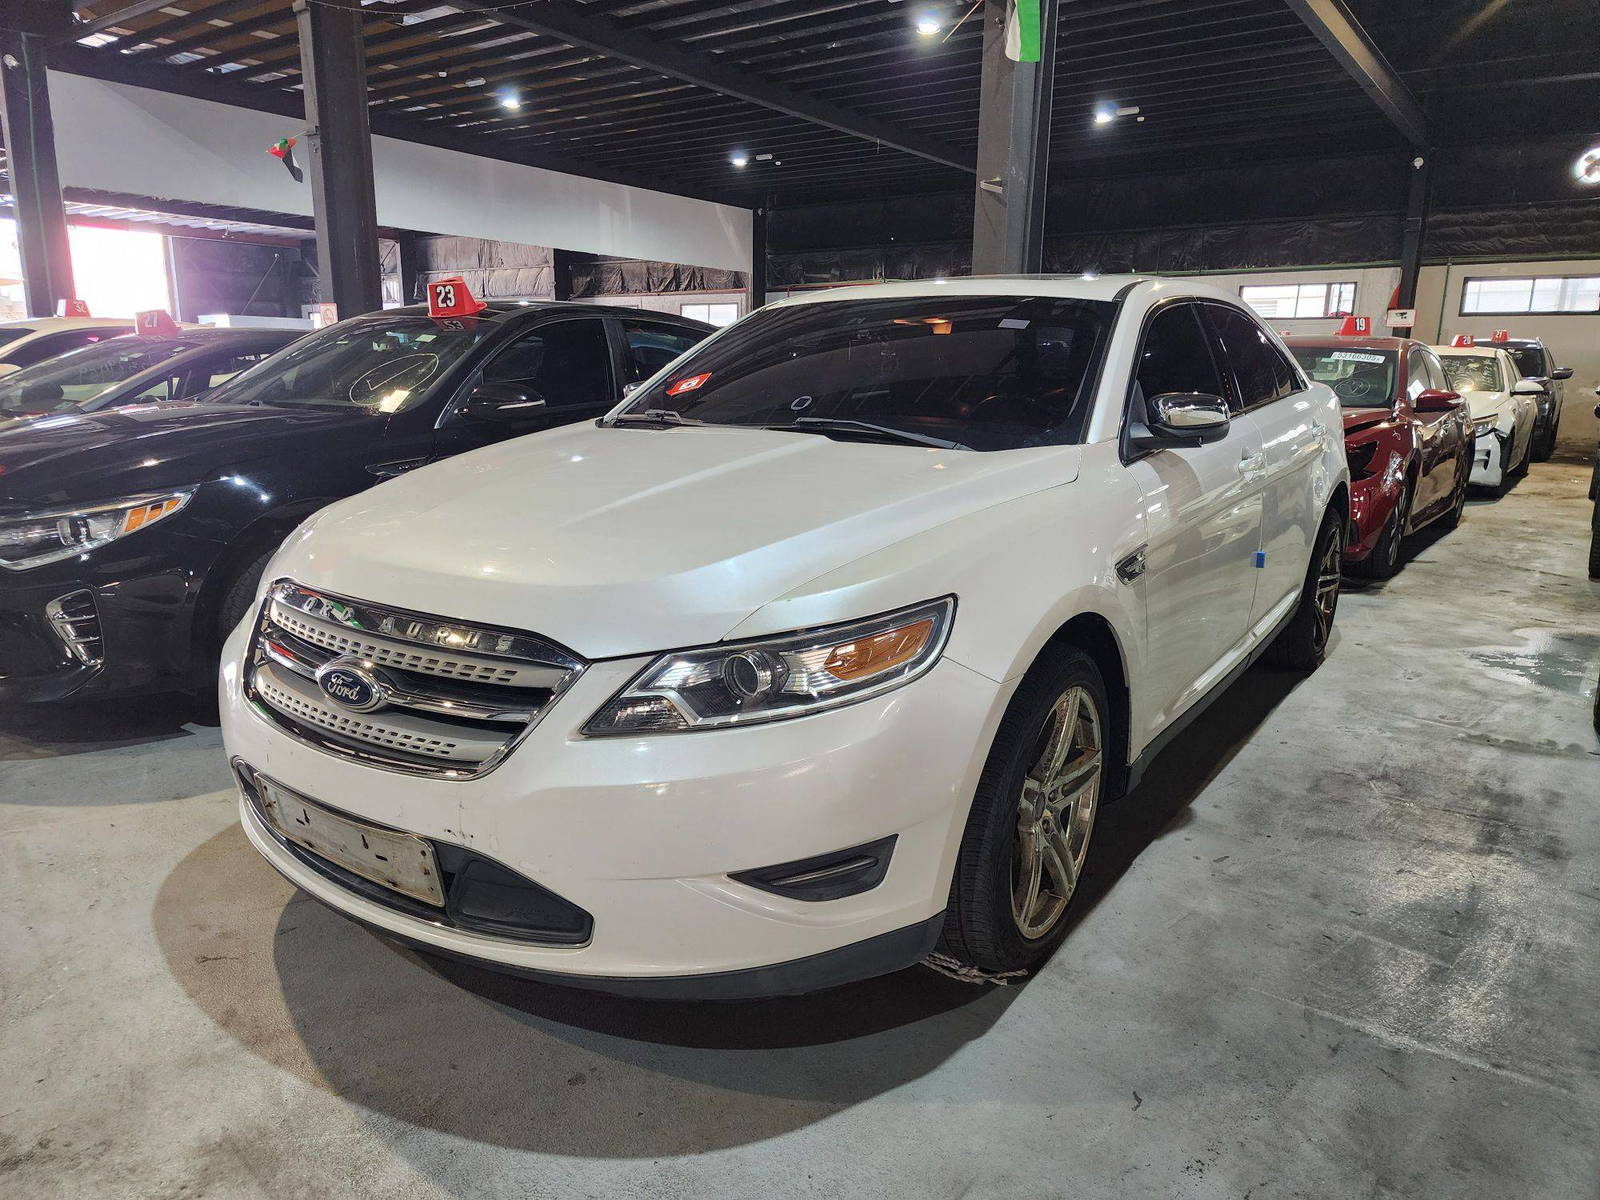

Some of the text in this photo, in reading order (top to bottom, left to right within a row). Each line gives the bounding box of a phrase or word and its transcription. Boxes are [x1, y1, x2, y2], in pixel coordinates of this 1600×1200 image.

[436, 285, 456, 308] 23
[1355, 317, 1366, 331] 19
[327, 672, 359, 701] Ford
